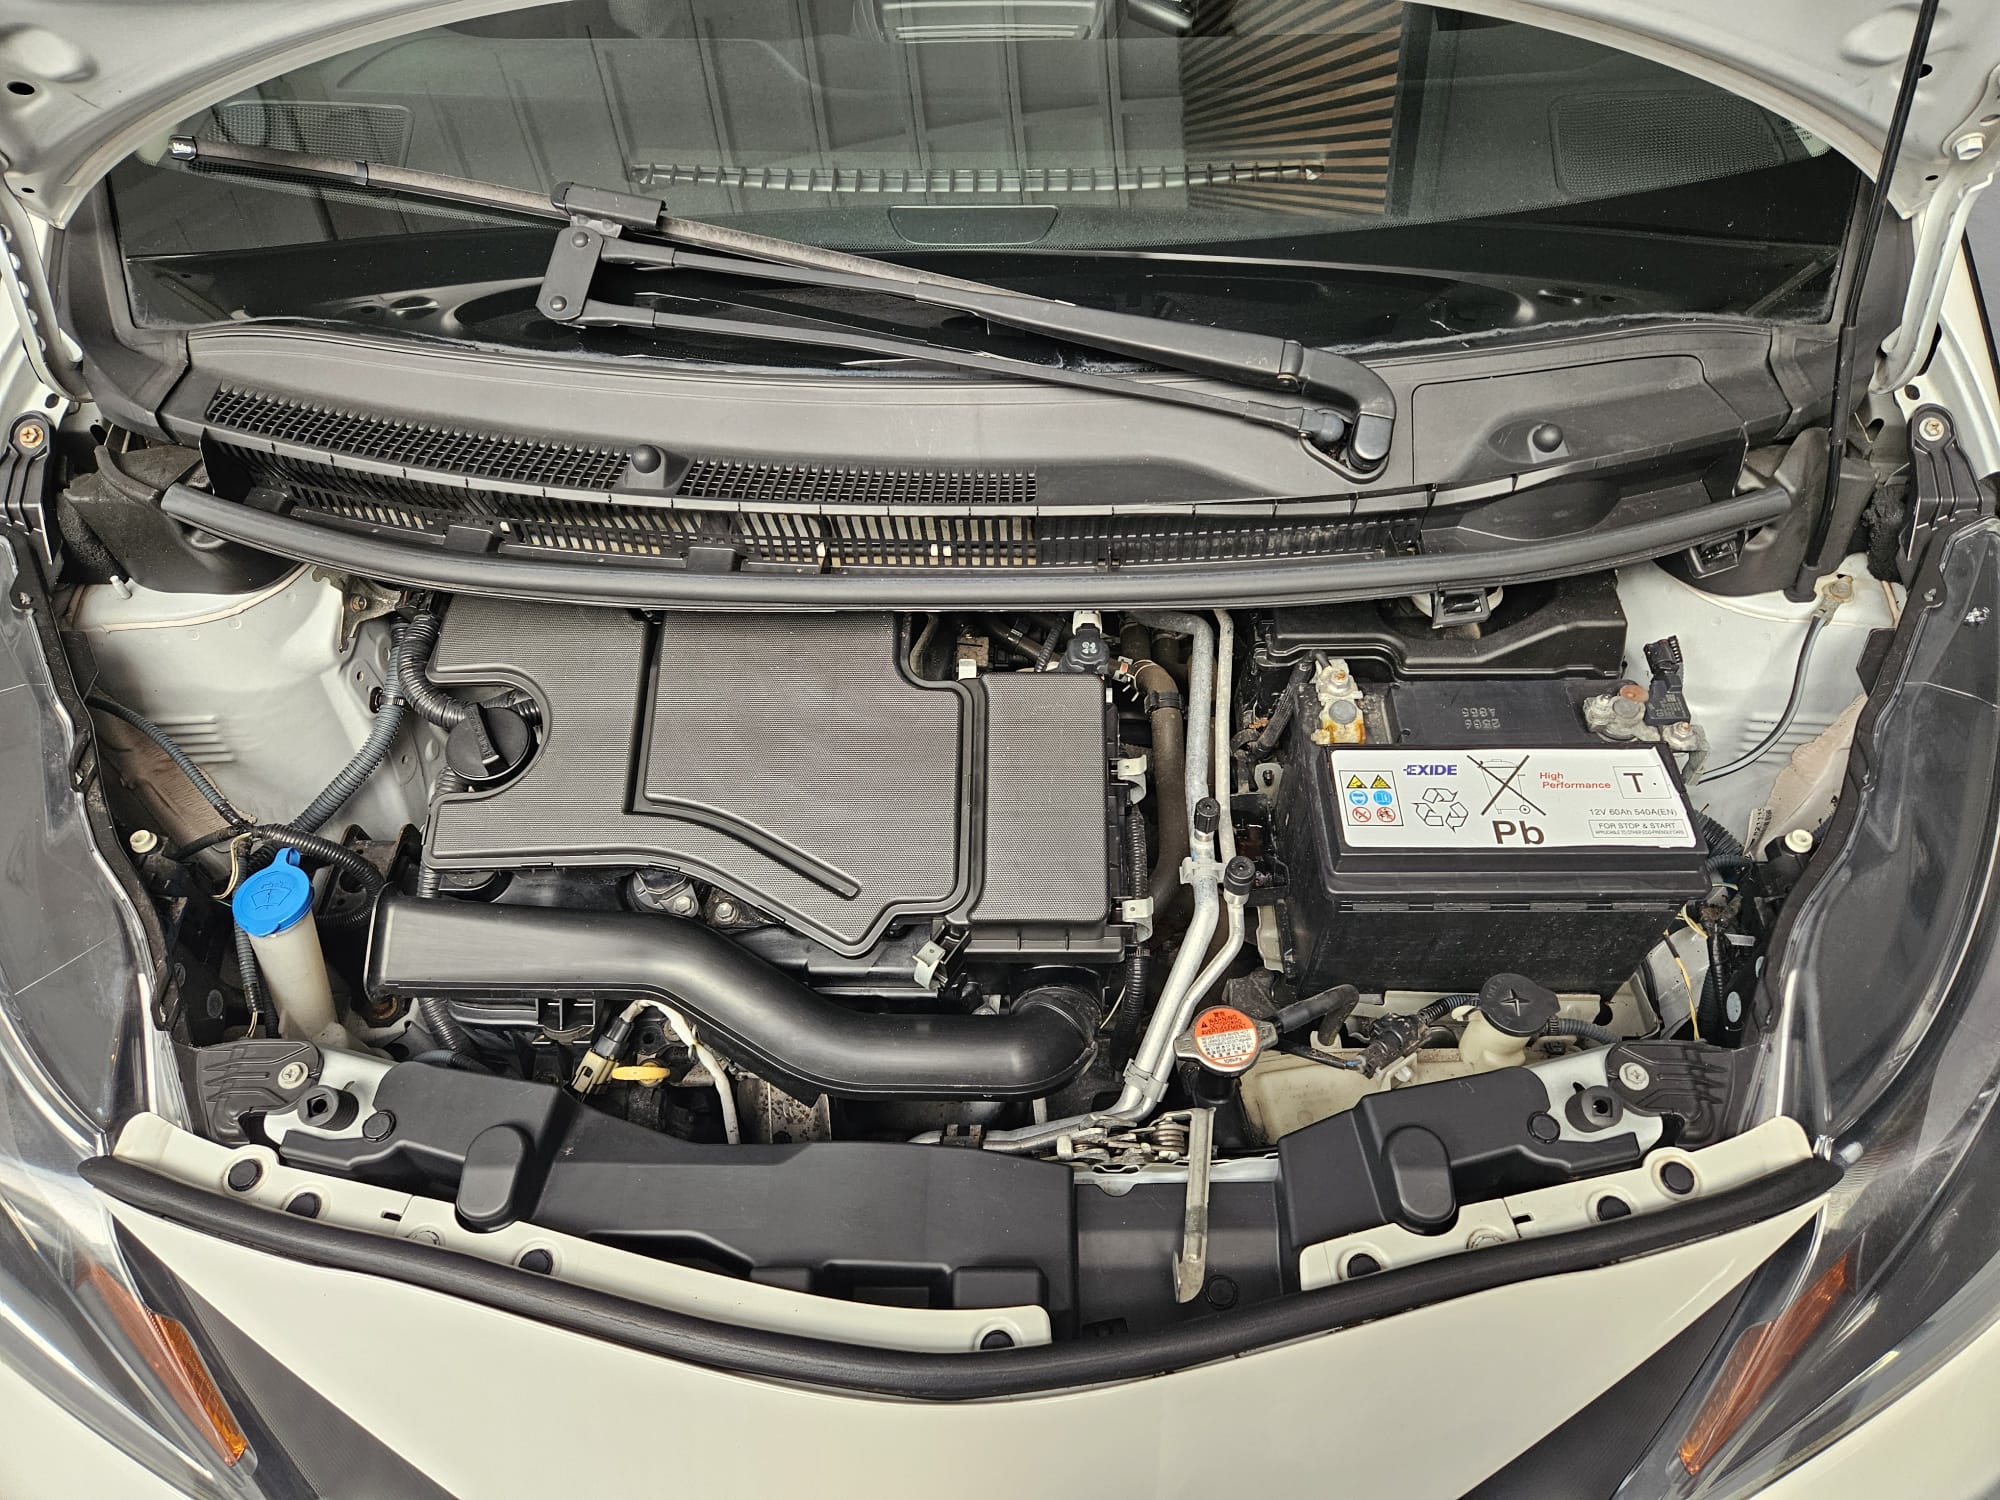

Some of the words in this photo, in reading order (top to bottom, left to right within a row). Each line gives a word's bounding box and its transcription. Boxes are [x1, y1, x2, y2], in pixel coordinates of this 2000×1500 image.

[1403, 764, 1458, 776] EXIDE
[1539, 772, 1564, 781] High
[1542, 781, 1611, 789] Performance
[1622, 772, 1643, 793] T
[1589, 808, 1606, 816] 12V
[1609, 808, 1632, 816] 60Ah
[1634, 808, 1677, 816] 540A(EN)
[1492, 820, 1545, 845] Pb
[1208, 1014, 1238, 1024] WARNING
